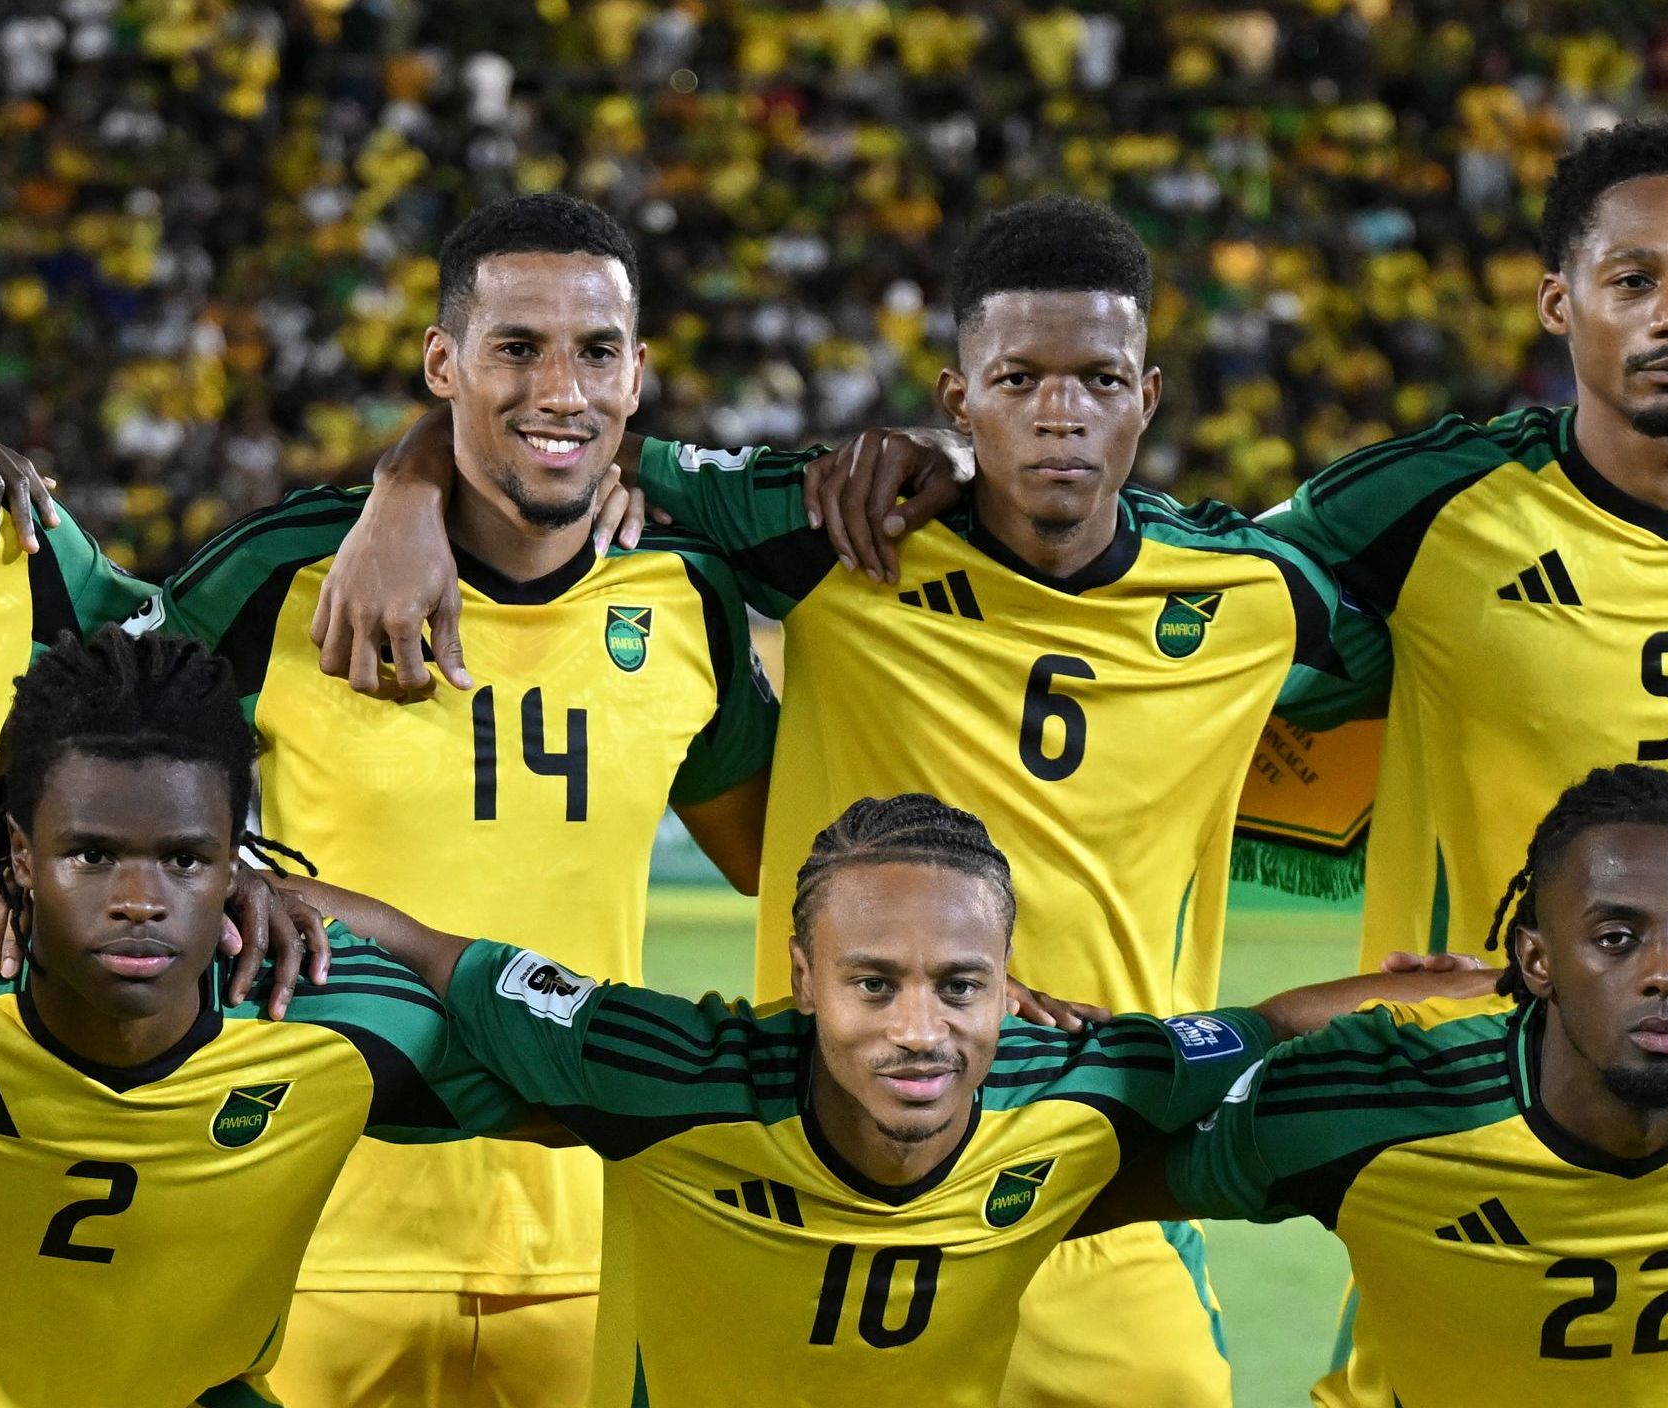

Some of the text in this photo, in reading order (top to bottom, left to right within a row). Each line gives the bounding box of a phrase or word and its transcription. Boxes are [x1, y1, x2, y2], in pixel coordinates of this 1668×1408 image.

[1159, 622, 1201, 637] JAMAICA
[473, 686, 587, 821] 14
[1020, 655, 1095, 781] 6
[217, 1113, 263, 1131] JAMAICA
[39, 1160, 138, 1264] 2
[989, 1189, 1031, 1212] JAMAICA
[809, 1243, 954, 1348] 10
